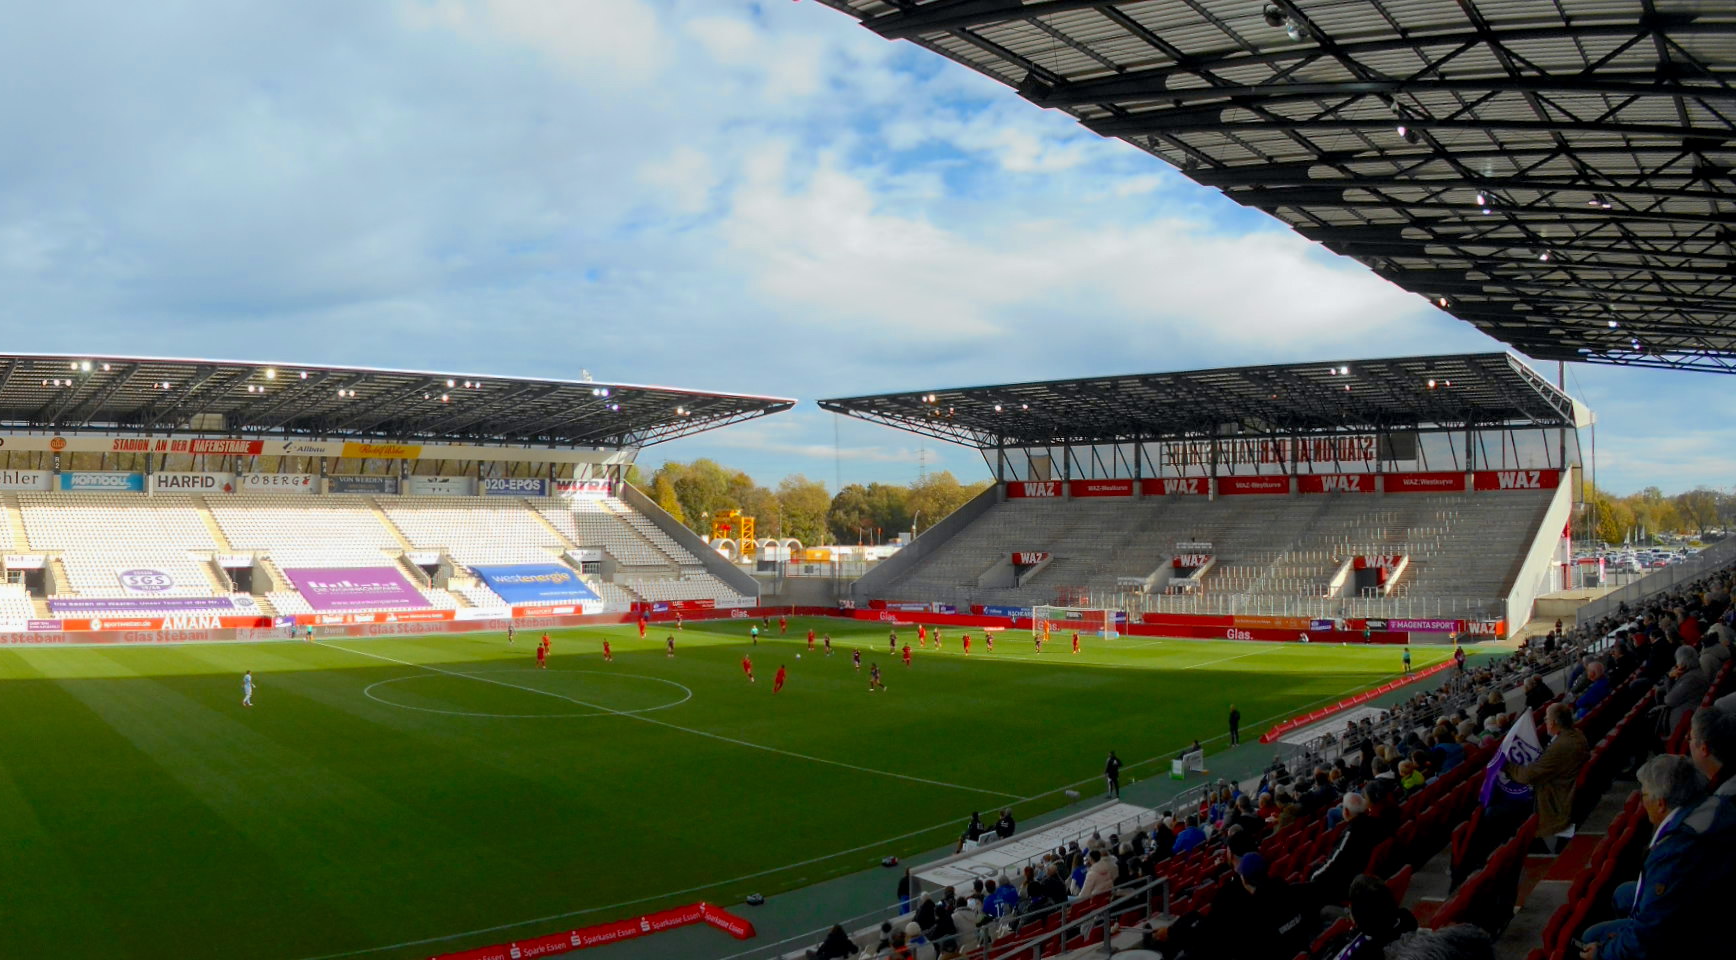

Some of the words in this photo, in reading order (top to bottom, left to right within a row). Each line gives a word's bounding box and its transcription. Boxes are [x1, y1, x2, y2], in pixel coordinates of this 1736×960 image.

[113, 439, 149, 451] STADION
[155, 440, 168, 451] AN
[170, 440, 188, 451] DER
[158, 476, 215, 488] HARFID
[1321, 475, 1361, 492] WAZ
[1496, 471, 1541, 489] WAZ
[1024, 482, 1055, 497] WAZ
[1164, 479, 1199, 494] WAZ
[1020, 552, 1044, 564] WAZ
[1180, 554, 1207, 567] WAZ
[1364, 556, 1395, 568] WAZ
[129, 575, 165, 585] SGS
[492, 572, 571, 584] westenergie
[730, 610, 750, 619] Glas.
[879, 611, 897, 621] Glas.
[161, 616, 223, 630] AMANA
[369, 624, 395, 635] Glas
[397, 622, 443, 634] Stebani
[515, 616, 556, 629] Stebani
[1037, 621, 1060, 632] Gas.
[1397, 621, 1430, 629] MAGENTA
[1431, 621, 1456, 629] SPORT
[1468, 622, 1497, 635] WAZ
[10, 632, 65, 644] Stebani
[124, 631, 157, 642] Glas
[158, 630, 209, 642] Stebani
[1226, 628, 1254, 641] Glas.
[652, 916, 683, 931] Sparkasse
[683, 911, 701, 924] Essen
[704, 911, 729, 930] Sparkasse
[726, 921, 745, 935] Essen
[583, 931, 615, 945] Sparkasse
[616, 927, 637, 939] Essen
[546, 942, 567, 954] Essen
